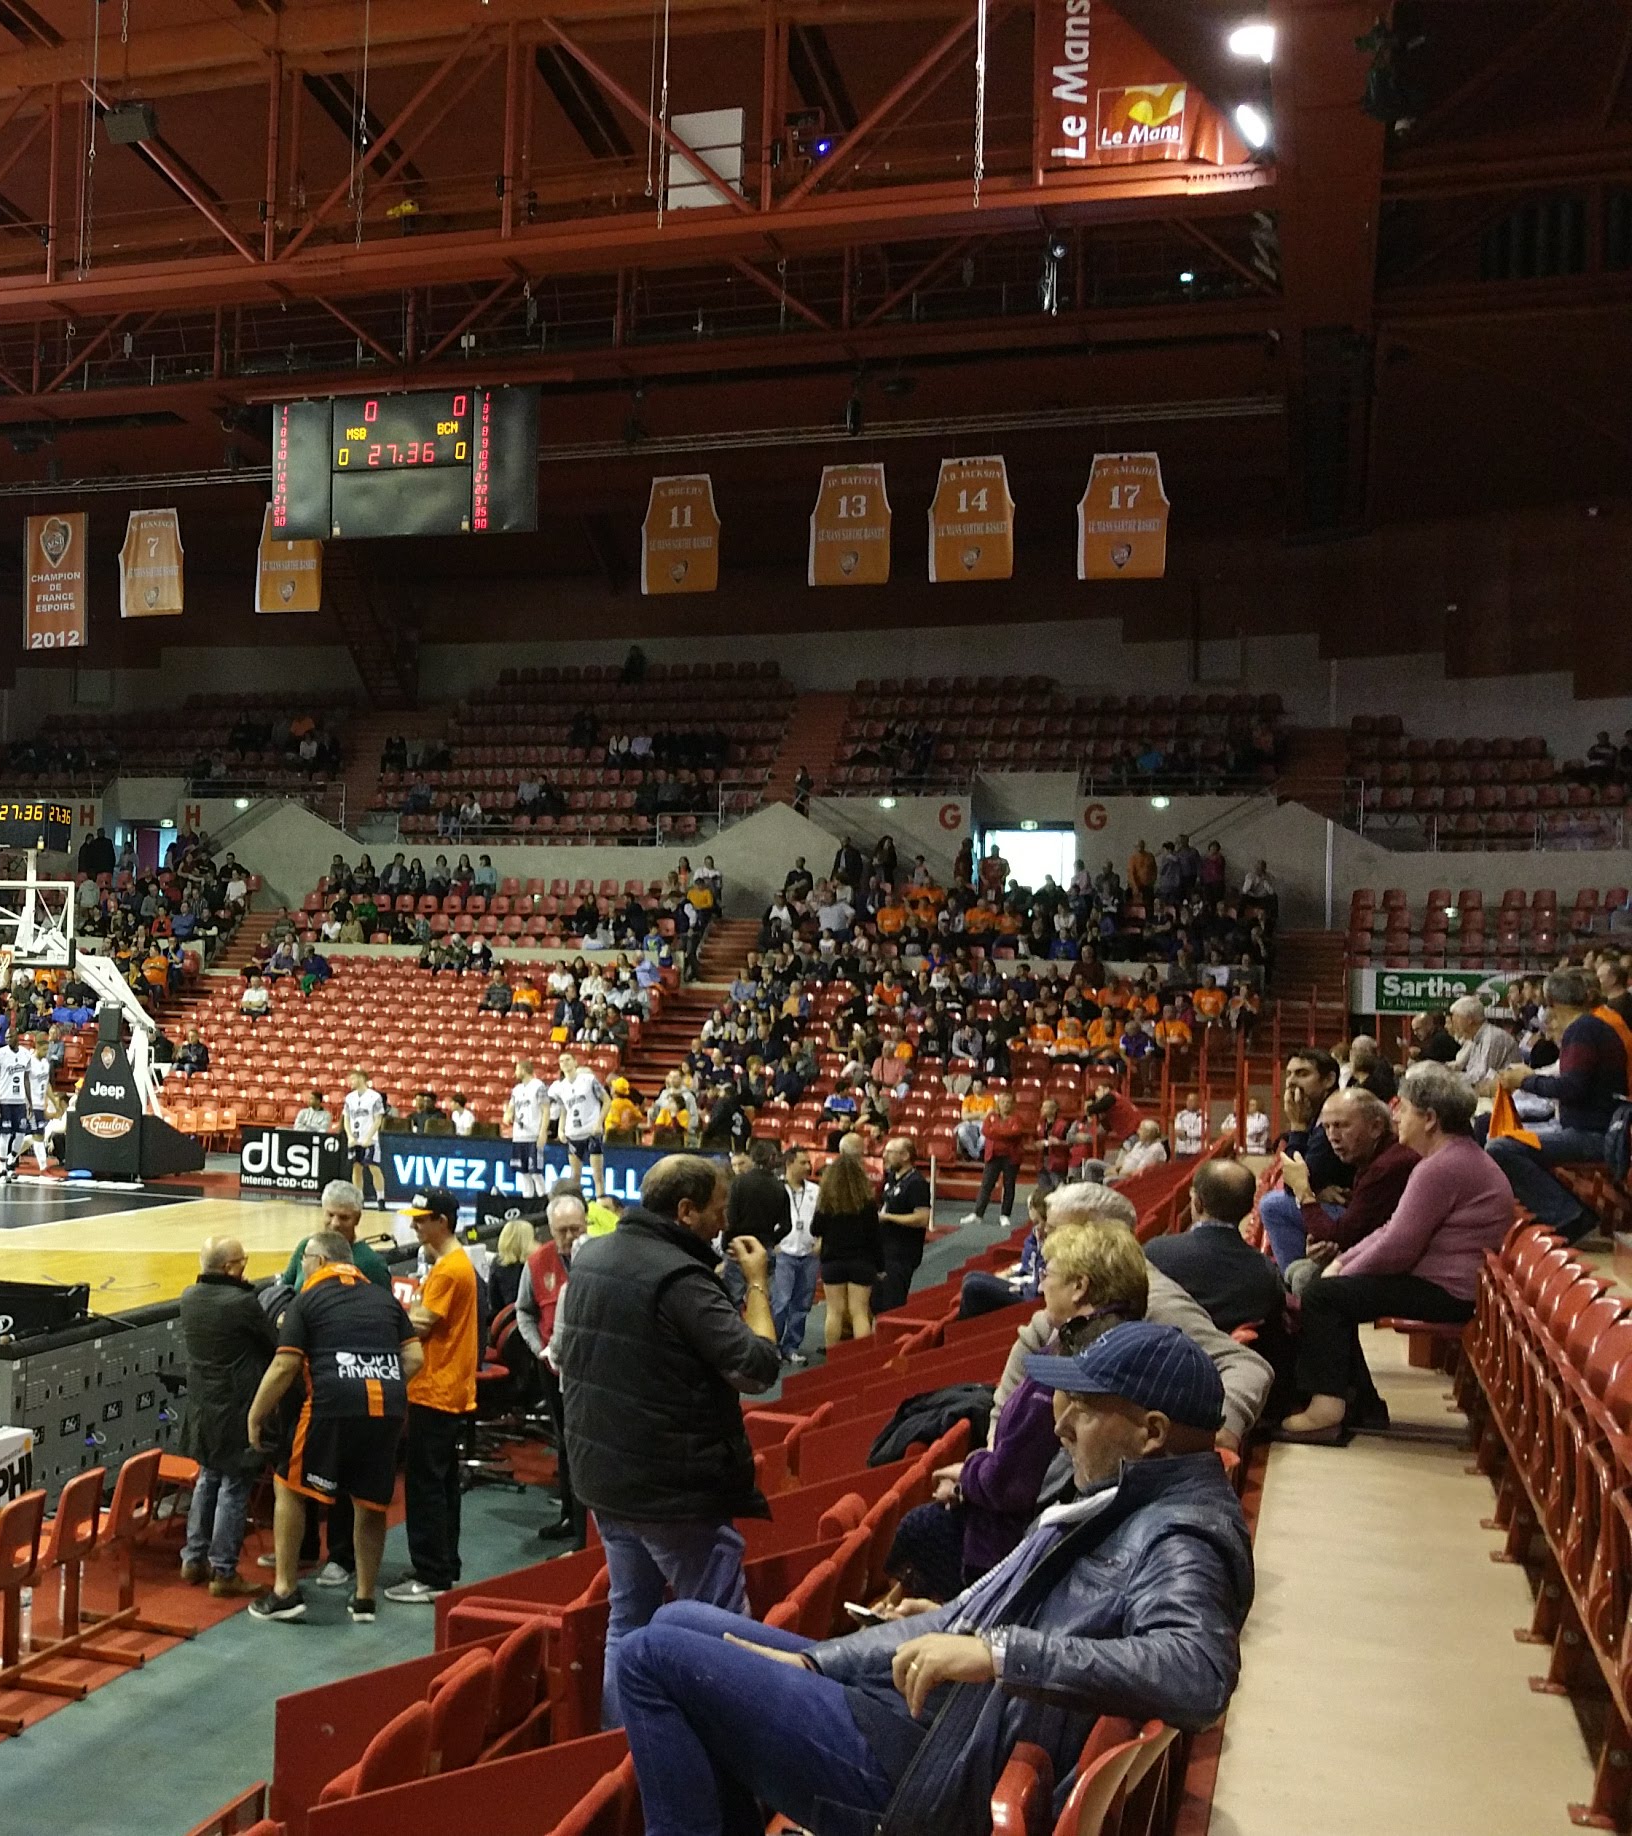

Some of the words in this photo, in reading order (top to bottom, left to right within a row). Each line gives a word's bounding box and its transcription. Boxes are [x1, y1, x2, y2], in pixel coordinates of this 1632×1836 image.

[1052, 0, 1090, 104] Mans
[1051, 115, 1086, 159] Le
[1101, 128, 1123, 146] Le
[1128, 124, 1180, 144] Mans
[365, 401, 378, 422] 0
[453, 395, 466, 417] 0
[346, 427, 367, 440] MSB
[437, 421, 459, 435] BCM
[338, 448, 349, 466] 0
[368, 442, 435, 466] 27:36
[455, 442, 466, 460] 0
[838, 494, 867, 518] 13
[957, 488, 988, 513] 14
[1109, 485, 1140, 509] 17
[670, 505, 693, 529] 11
[147, 537, 159, 557] 7
[31, 571, 81, 583] CHAMPION
[49, 583, 62, 591] DE
[35, 603, 75, 612] ESPOIRS
[37, 593, 74, 603] FRANCE
[31, 630, 80, 649] 2012
[49, 806, 71, 824] 27:36
[80, 805, 94, 826] H
[186, 805, 200, 827] H
[939, 803, 961, 830] G
[1084, 803, 1107, 830] G
[1383, 974, 1467, 998] Sarthe
[90, 1081, 125, 1100] Jeep
[90, 1116, 130, 1132] Gaulois
[241, 1132, 319, 1178] dlsi
[393, 1154, 486, 1190] VIVEZ
